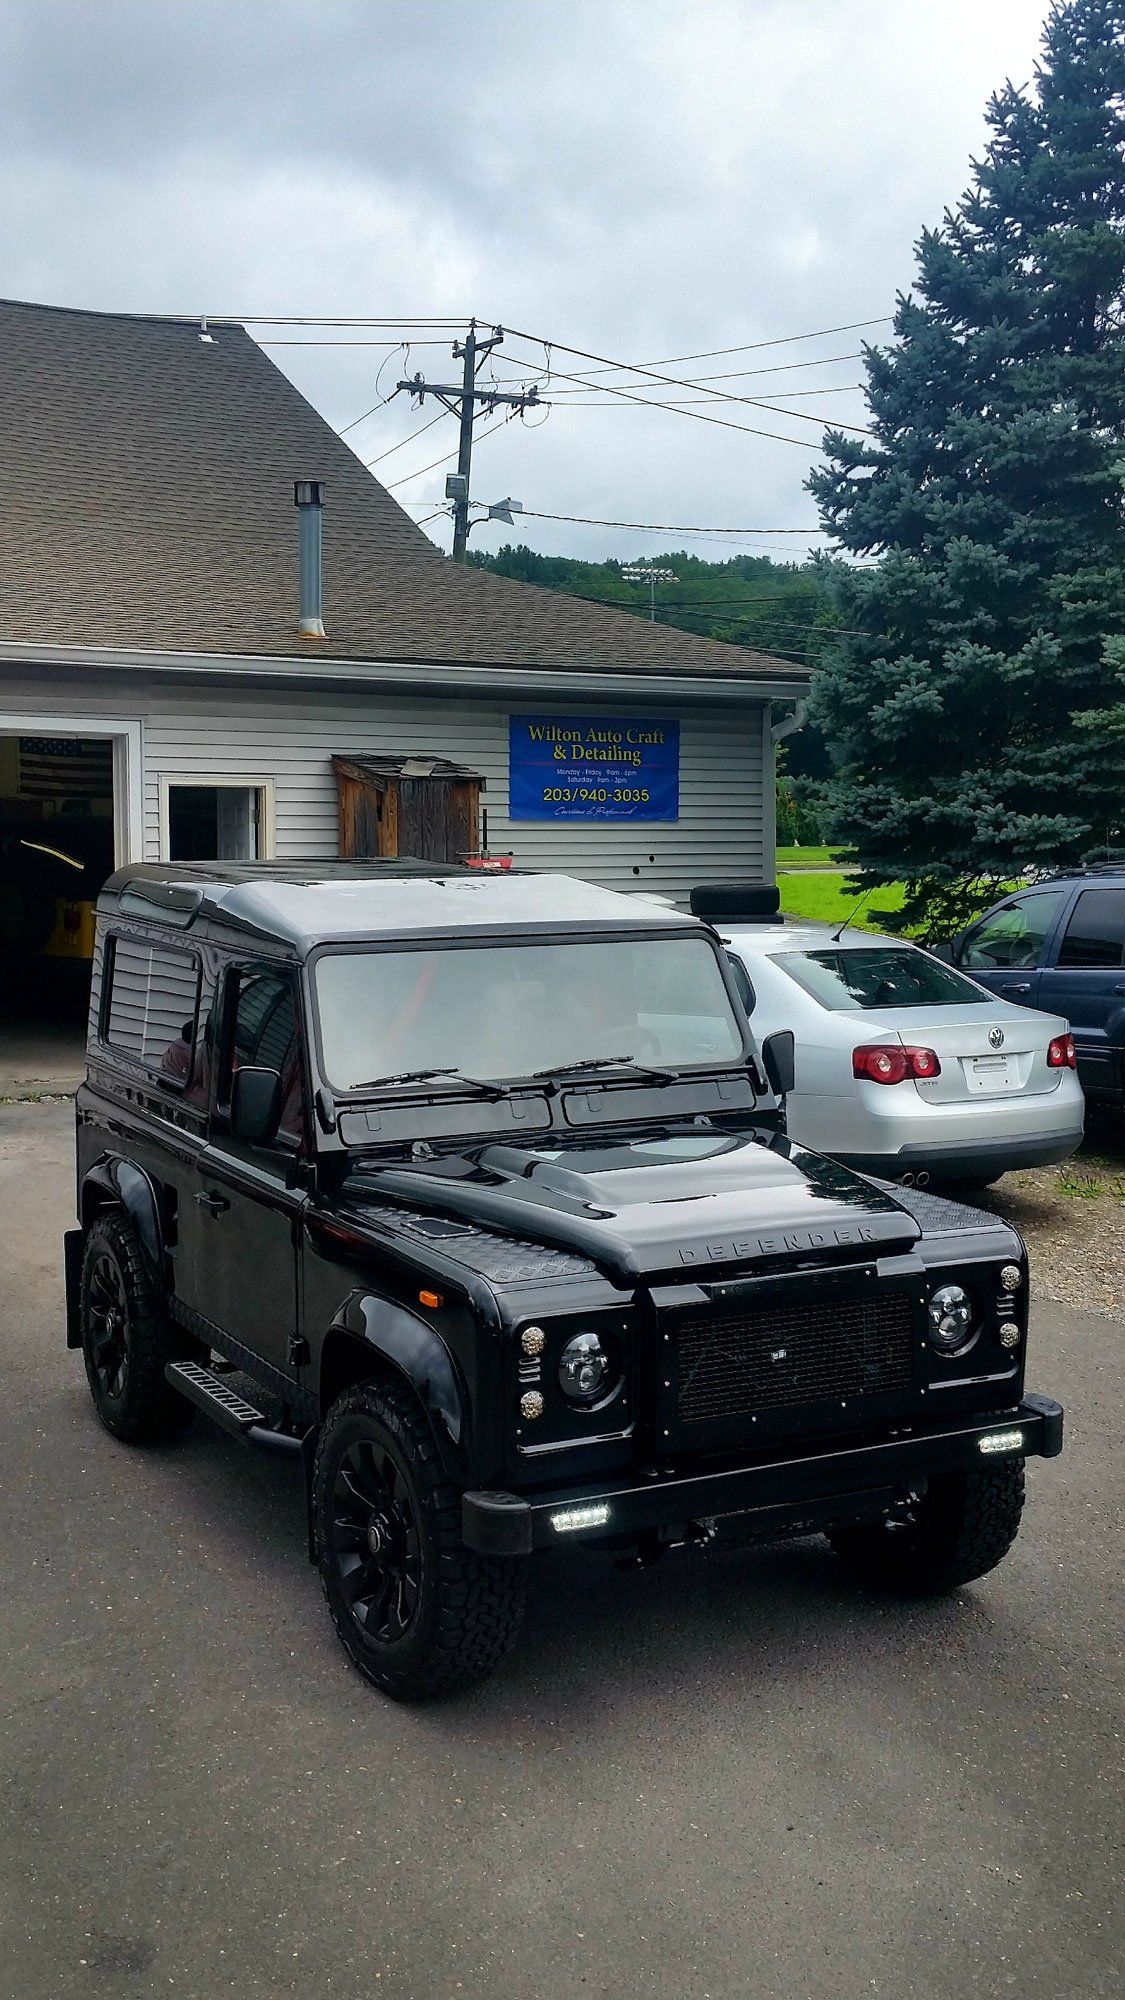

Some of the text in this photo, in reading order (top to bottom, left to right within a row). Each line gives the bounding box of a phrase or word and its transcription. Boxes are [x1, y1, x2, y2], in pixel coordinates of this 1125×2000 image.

[528, 725, 664, 744] Wilton Auto Craft
[553, 744, 641, 766] & Detailing
[556, 768, 581, 776] Monday
[585, 769, 602, 777] Friday
[567, 776, 593, 784] Saturday
[543, 787, 650, 803] 203/940-3035
[678, 1227, 878, 1265] DEFENDER
